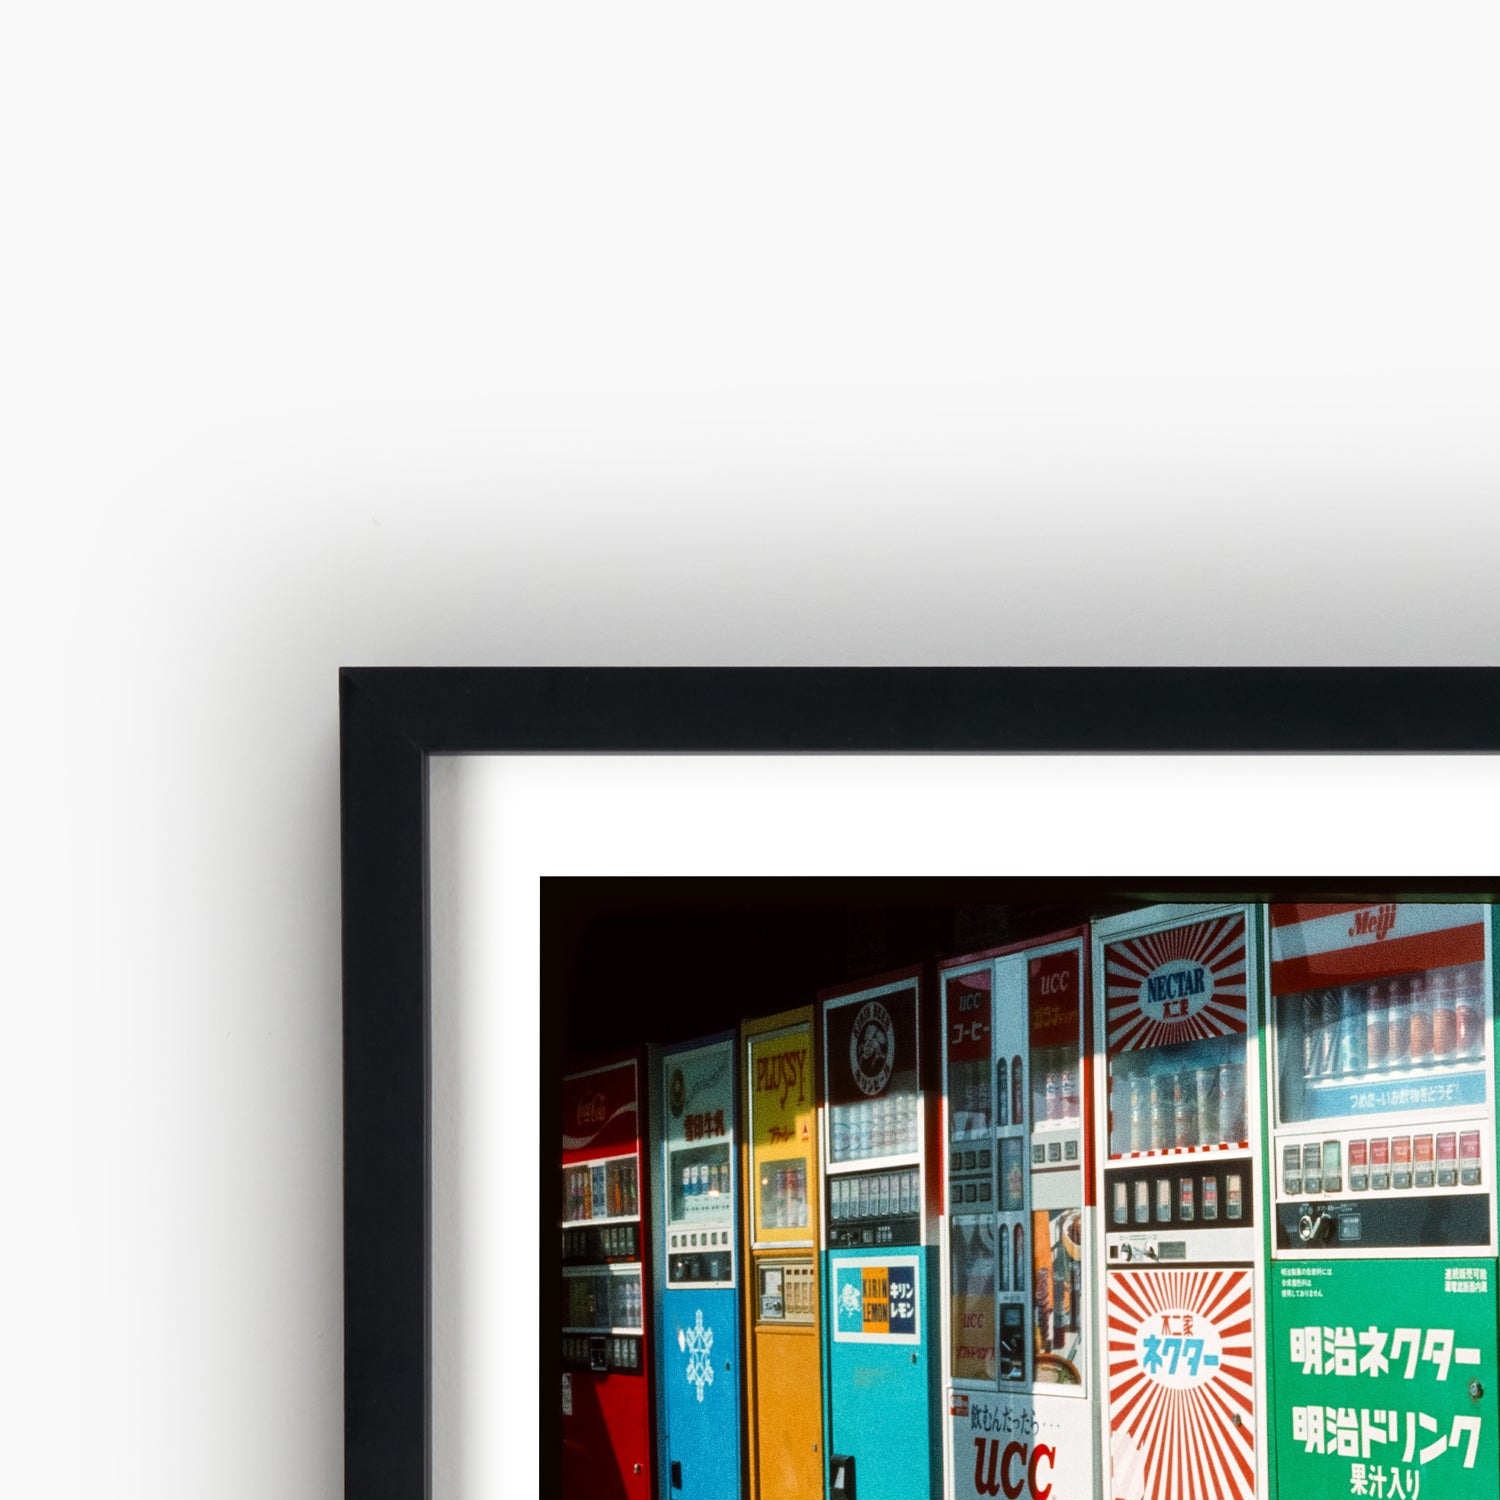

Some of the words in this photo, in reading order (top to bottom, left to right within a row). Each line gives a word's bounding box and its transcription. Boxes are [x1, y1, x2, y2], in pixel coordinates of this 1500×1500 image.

[1348, 904, 1397, 941] Meiji
[1147, 968, 1205, 1004] NECTAR
[951, 1021, 990, 1045] コーヒー
[862, 1277, 888, 1298] KIRIN
[890, 1282, 914, 1300] キリン
[862, 1302, 888, 1323] LEMON
[890, 1302, 914, 1319] レモン
[1161, 1315, 1194, 1336] 不二家
[1143, 1334, 1219, 1376] ネクター
[1289, 1326, 1481, 1381] 明治ネクター
[1292, 1405, 1482, 1469] 明治ドリンク
[1350, 1462, 1420, 1500] 果汁入り
